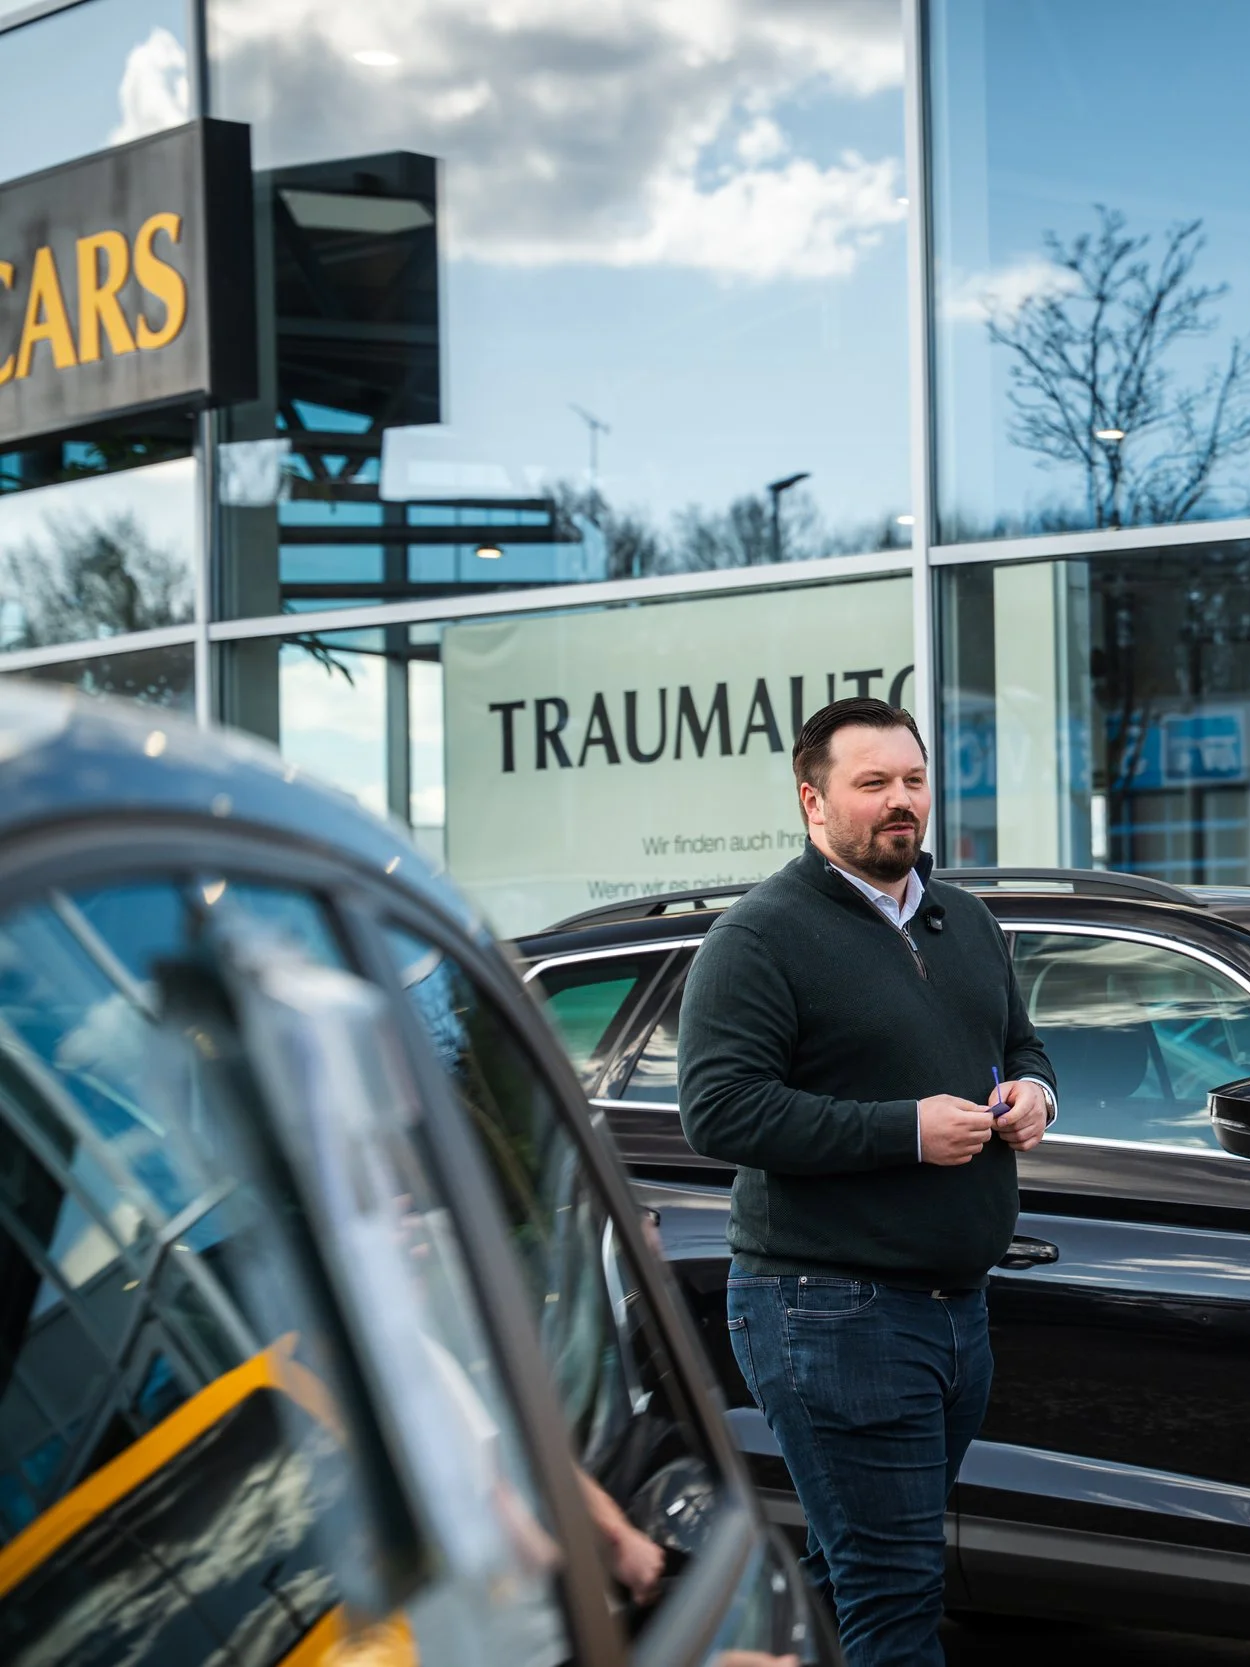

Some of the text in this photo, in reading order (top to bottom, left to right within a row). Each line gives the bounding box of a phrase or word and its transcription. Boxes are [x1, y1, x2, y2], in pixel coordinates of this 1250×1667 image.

[0, 211, 188, 386] ARS
[642, 837, 669, 856] Wir
[674, 834, 726, 853] finden
[730, 833, 772, 852] auch
[587, 880, 637, 899] Wenn
[641, 877, 664, 895] wir
